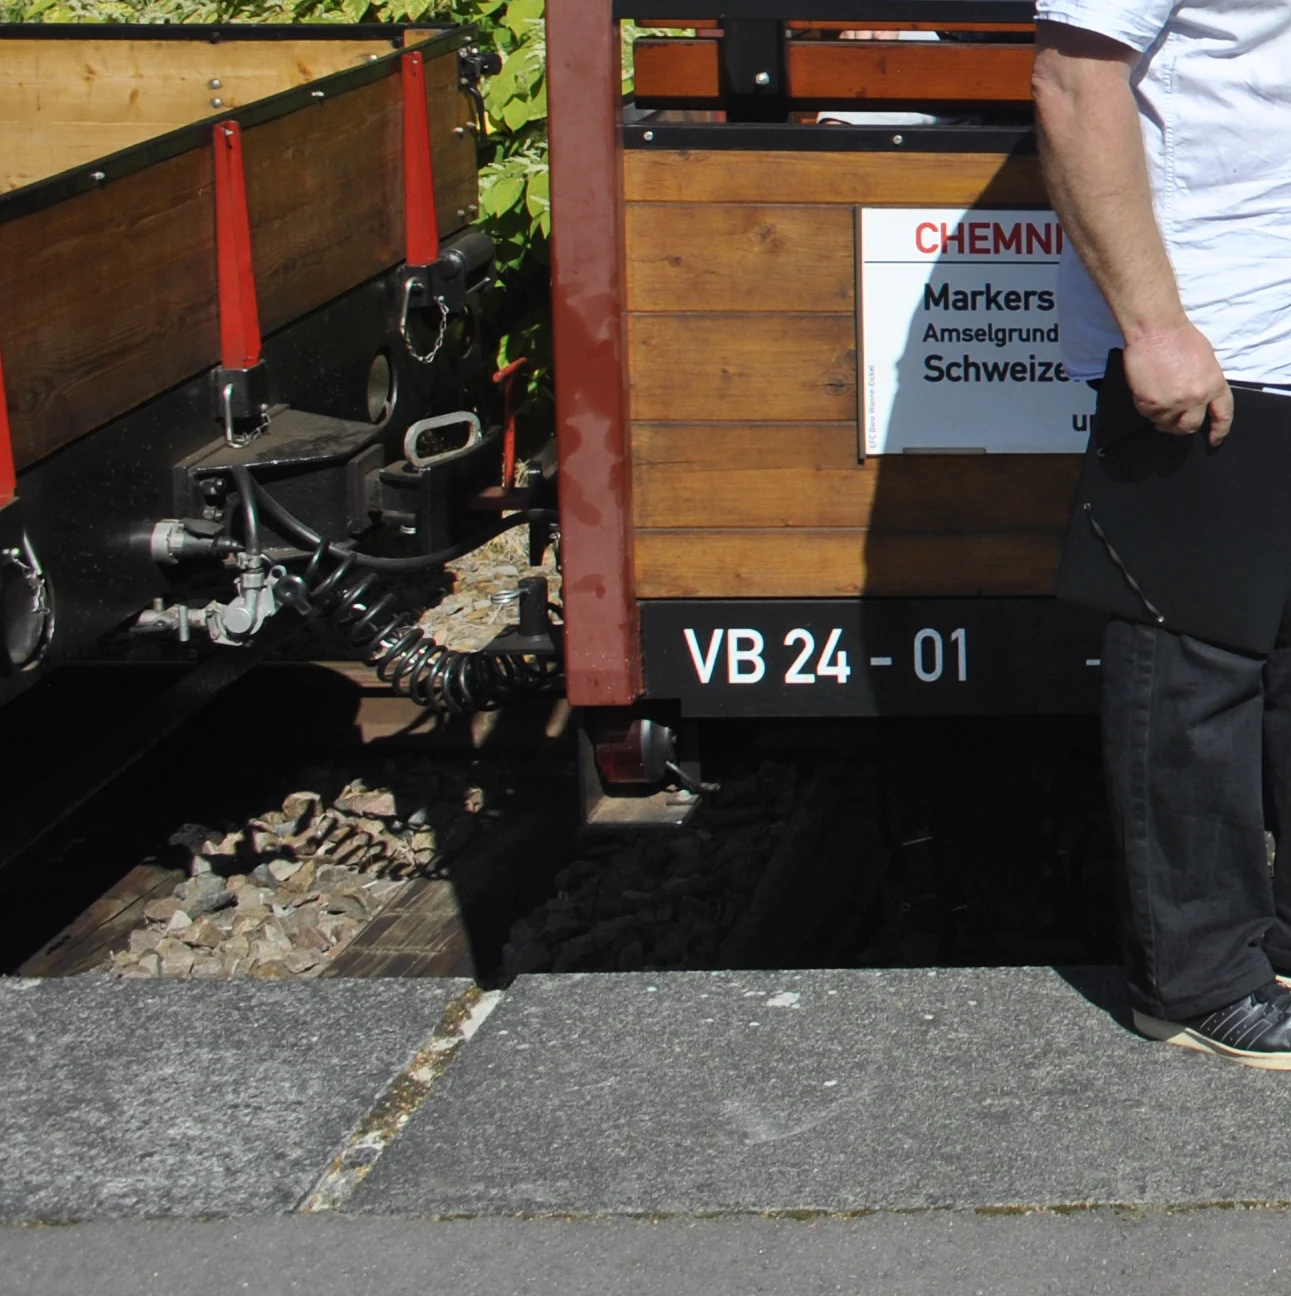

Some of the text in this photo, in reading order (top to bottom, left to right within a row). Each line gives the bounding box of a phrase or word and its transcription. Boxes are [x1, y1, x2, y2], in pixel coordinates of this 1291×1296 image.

[923, 282, 1055, 312] Markers
[922, 322, 1059, 348] Amselgrund
[923, 354, 1079, 383] Schweize
[684, 628, 766, 684] VB
[783, 628, 851, 684] 24
[914, 627, 967, 682] 01
